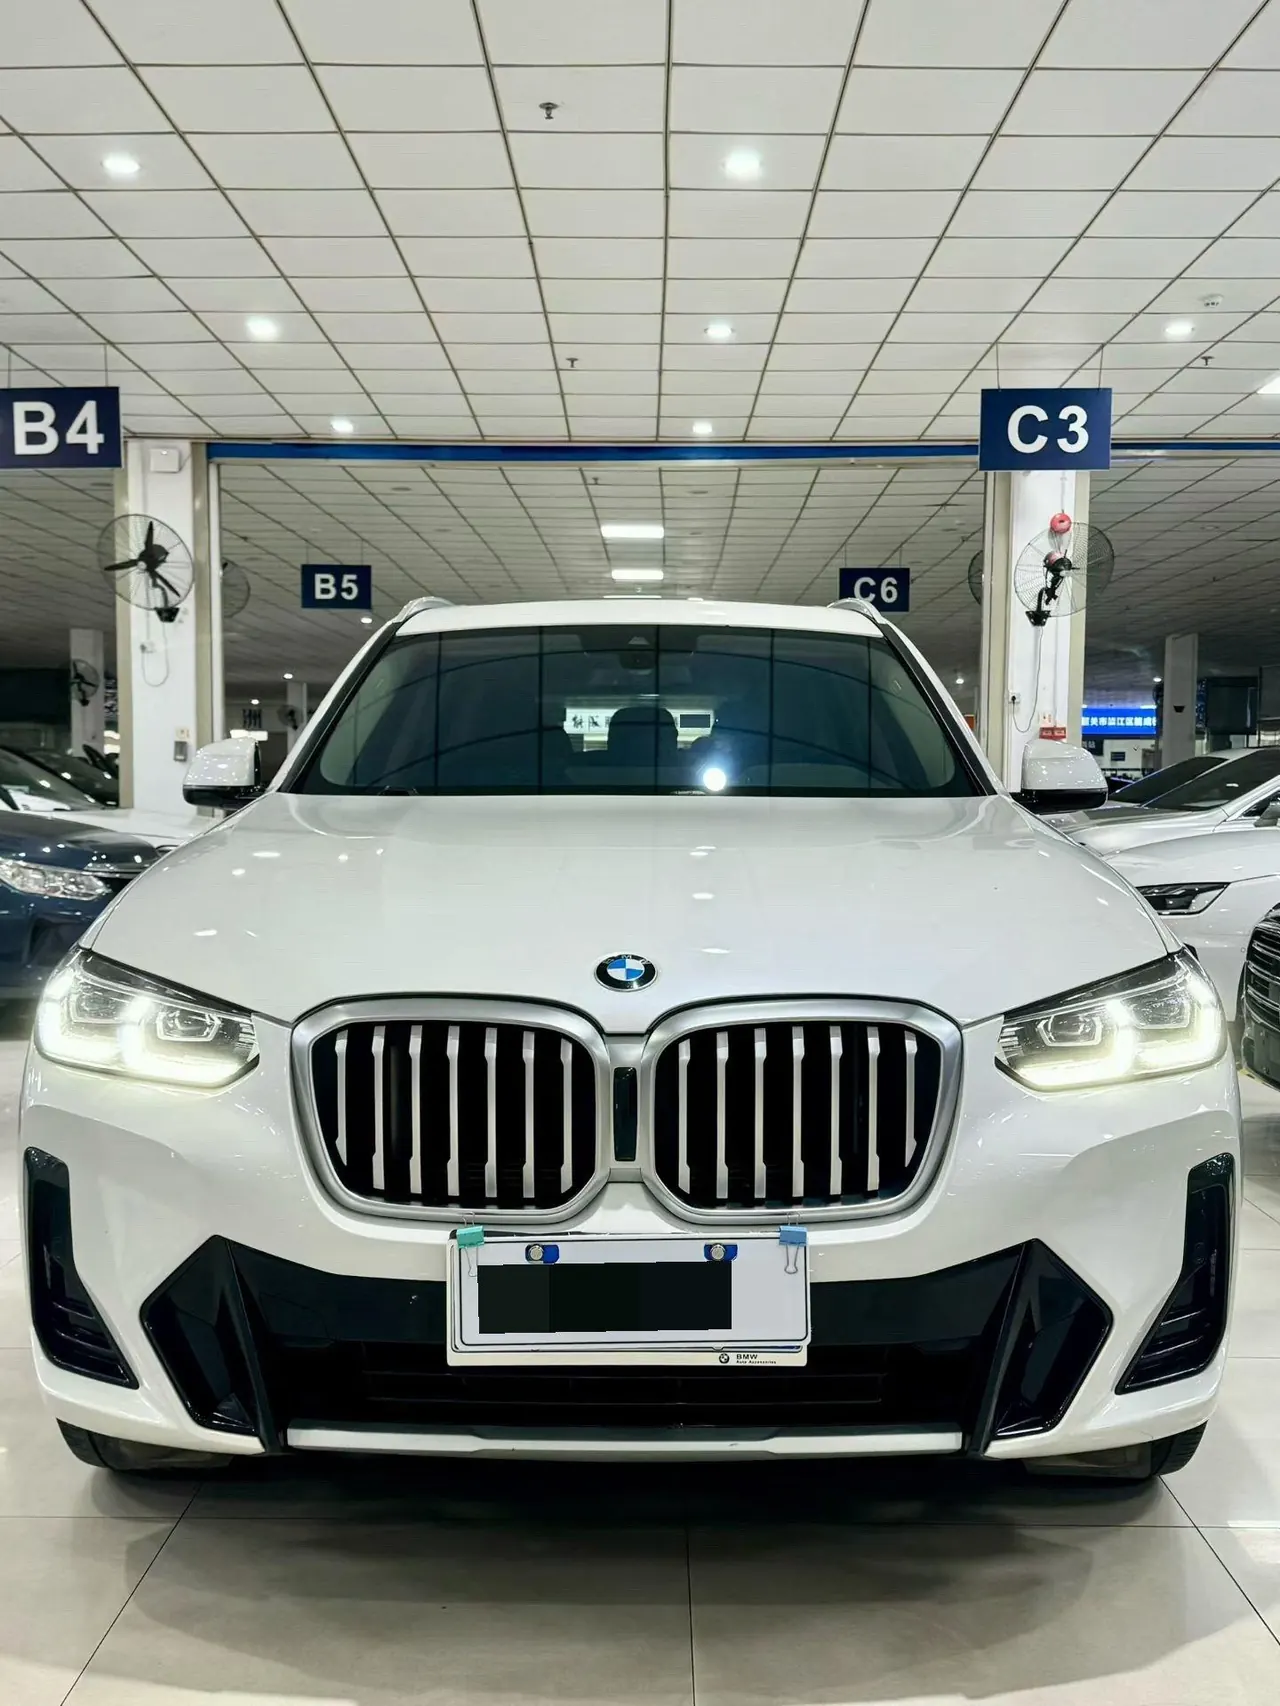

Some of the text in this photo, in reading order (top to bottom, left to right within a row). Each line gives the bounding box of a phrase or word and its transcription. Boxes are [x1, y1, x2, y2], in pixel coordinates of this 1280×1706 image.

[12, 400, 105, 455] B4
[1007, 405, 1089, 454] C3
[314, 573, 358, 600] B5
[853, 576, 898, 604] C6
